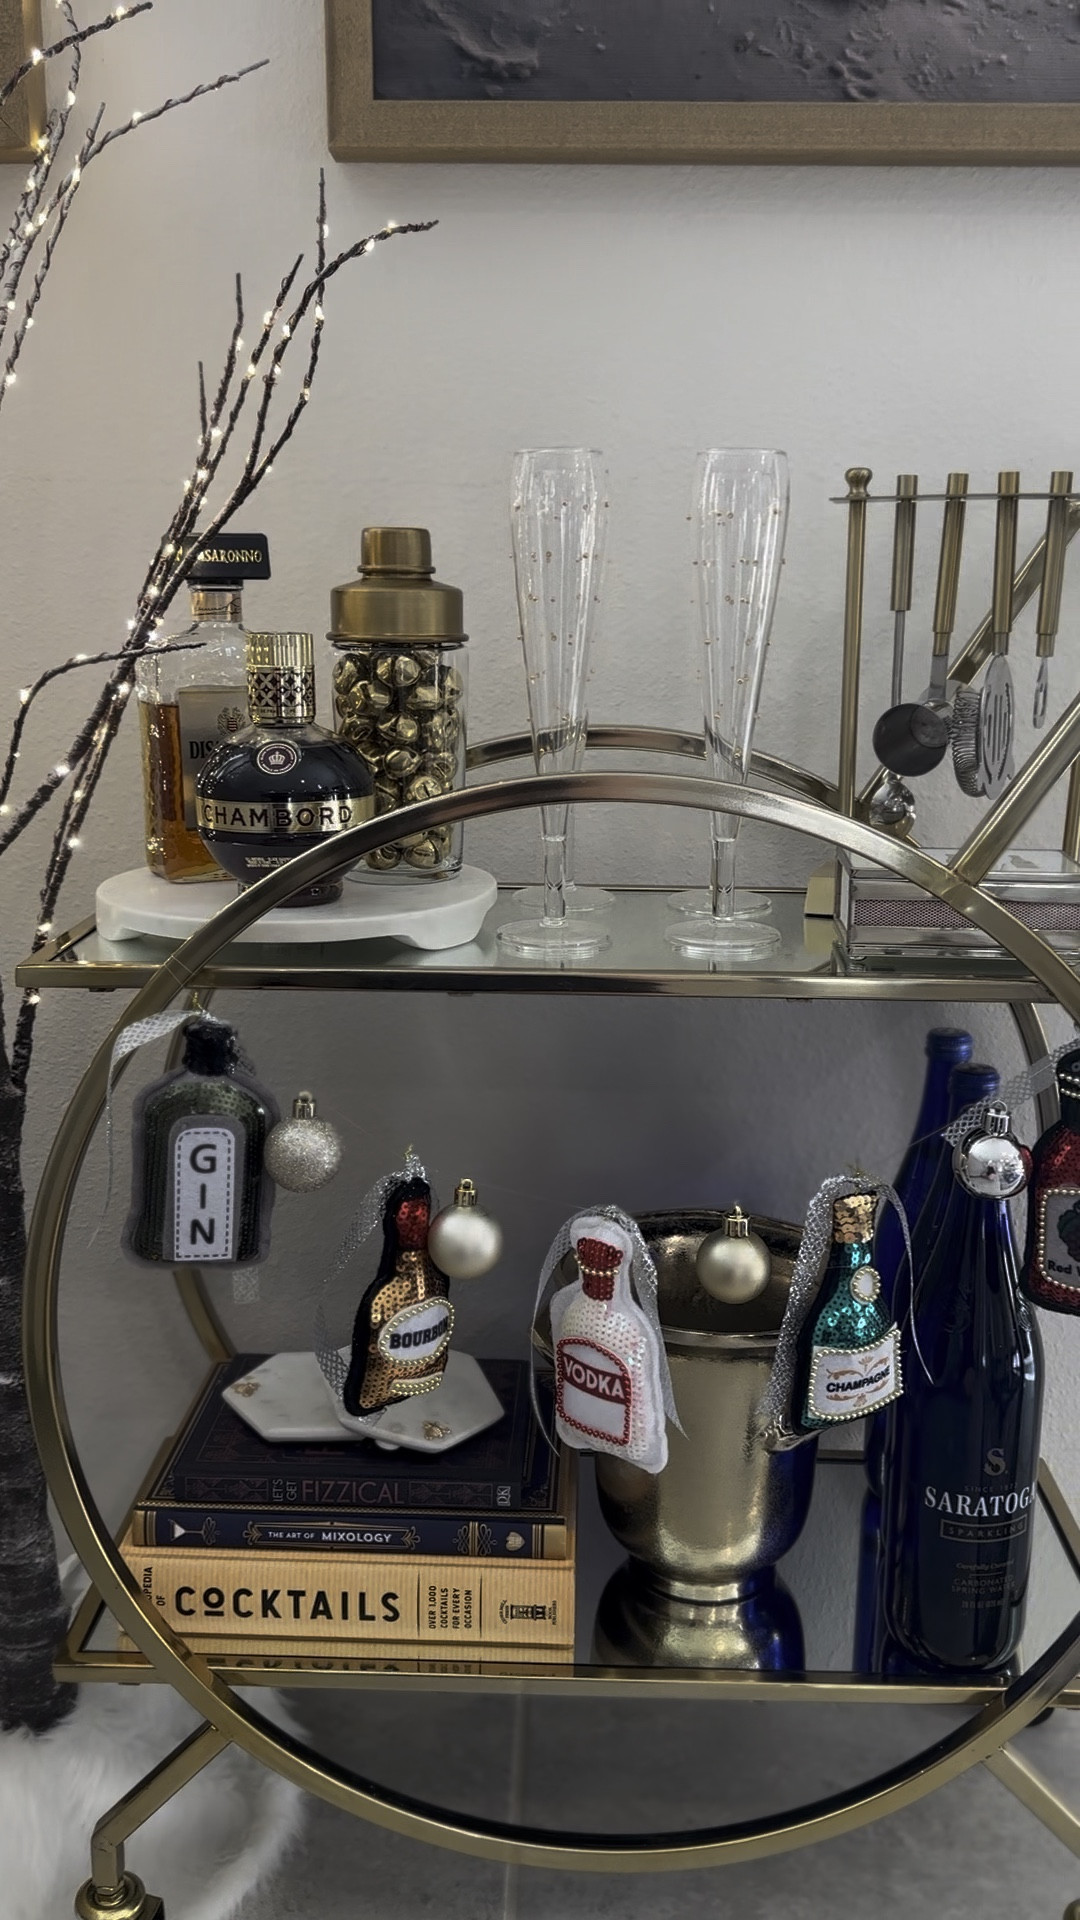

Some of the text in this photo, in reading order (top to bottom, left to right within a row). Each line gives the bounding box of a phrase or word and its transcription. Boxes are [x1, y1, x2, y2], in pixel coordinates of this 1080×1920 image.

[203, 804, 353, 828] CHAMBORD
[189, 1143, 217, 1246] GIN
[1047, 1259, 1073, 1275] Red
[389, 1315, 449, 1350] BOURBON
[563, 1356, 625, 1399] VODKA
[826, 1365, 890, 1393] CHAMPAGNE
[272, 1478, 284, 1502] LET'S
[286, 1480, 298, 1501] GET
[301, 1479, 405, 1506] FIZZICAL
[496, 1485, 512, 1507] DK
[268, 1531, 393, 1544] THE ART OF MIXOLOGY
[949, 1522, 1024, 1538] SPARKLING
[156, 1594, 166, 1607] OF
[175, 1586, 401, 1623] COCKTAILS
[428, 1585, 438, 1630] OVER 1,000
[440, 1587, 449, 1629] COCKTAILS
[452, 1587, 461, 1630] FOR EVERY
[464, 1589, 473, 1629] OCCASION
